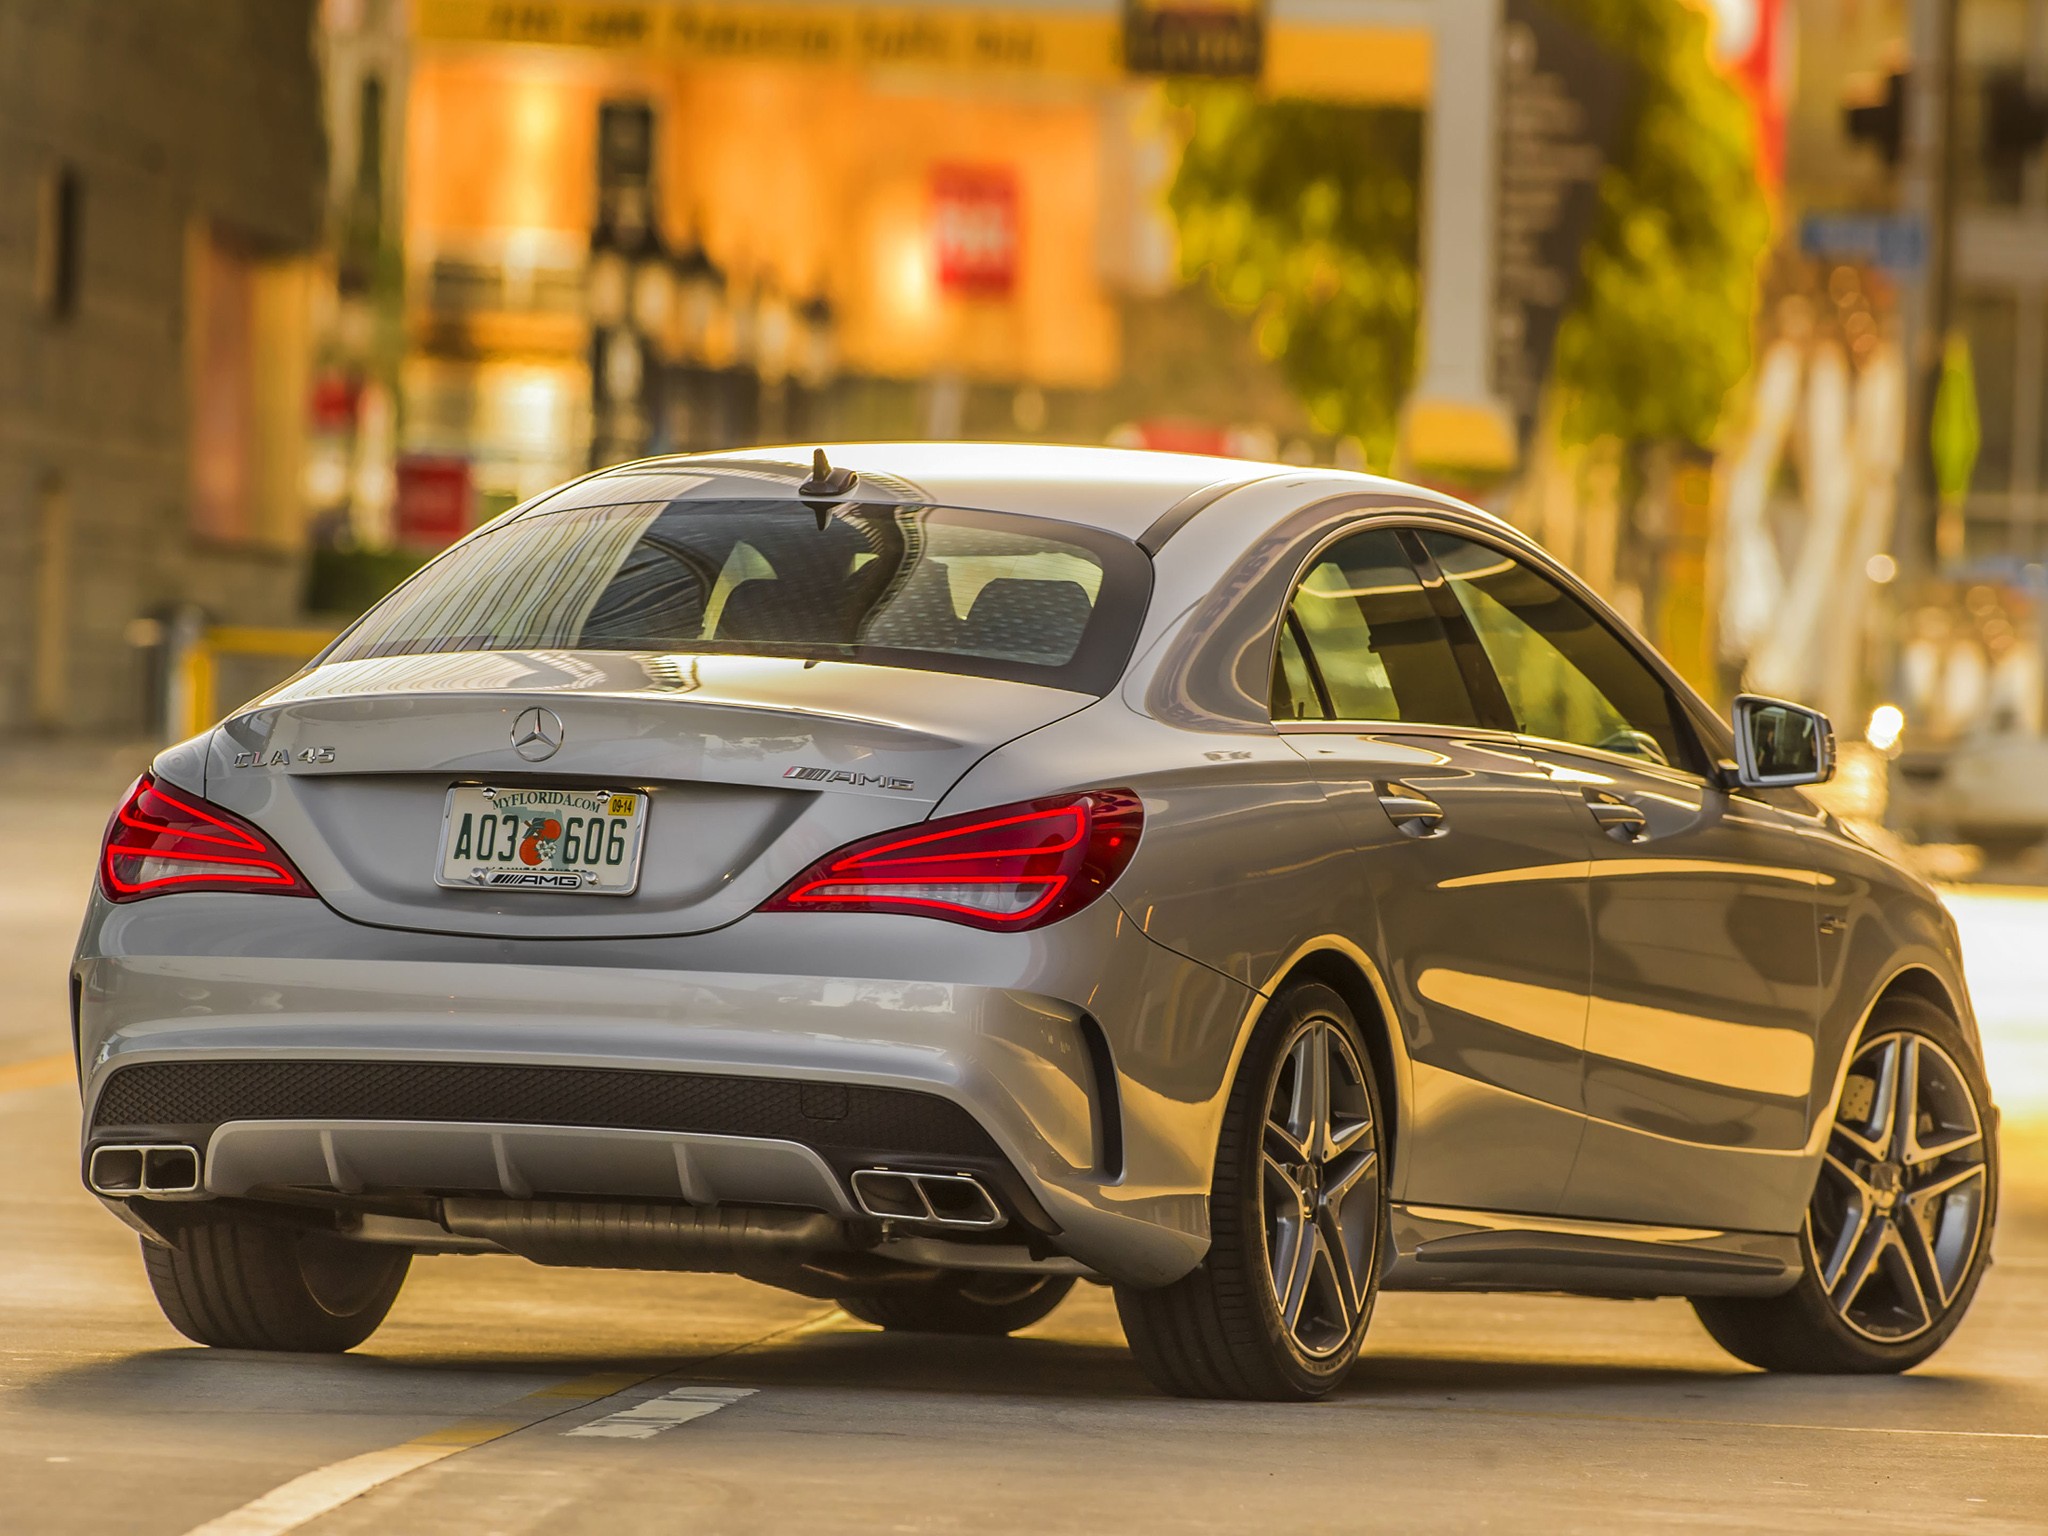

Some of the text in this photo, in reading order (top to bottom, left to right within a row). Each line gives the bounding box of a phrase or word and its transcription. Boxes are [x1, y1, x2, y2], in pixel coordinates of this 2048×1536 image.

[234, 746, 336, 769] CLA 45
[826, 770, 914, 791] AMG
[492, 791, 600, 813] MYFLORIDA.COM
[612, 799, 632, 813] 09-14
[563, 817, 627, 865] 606
[518, 875, 577, 886] AMG
